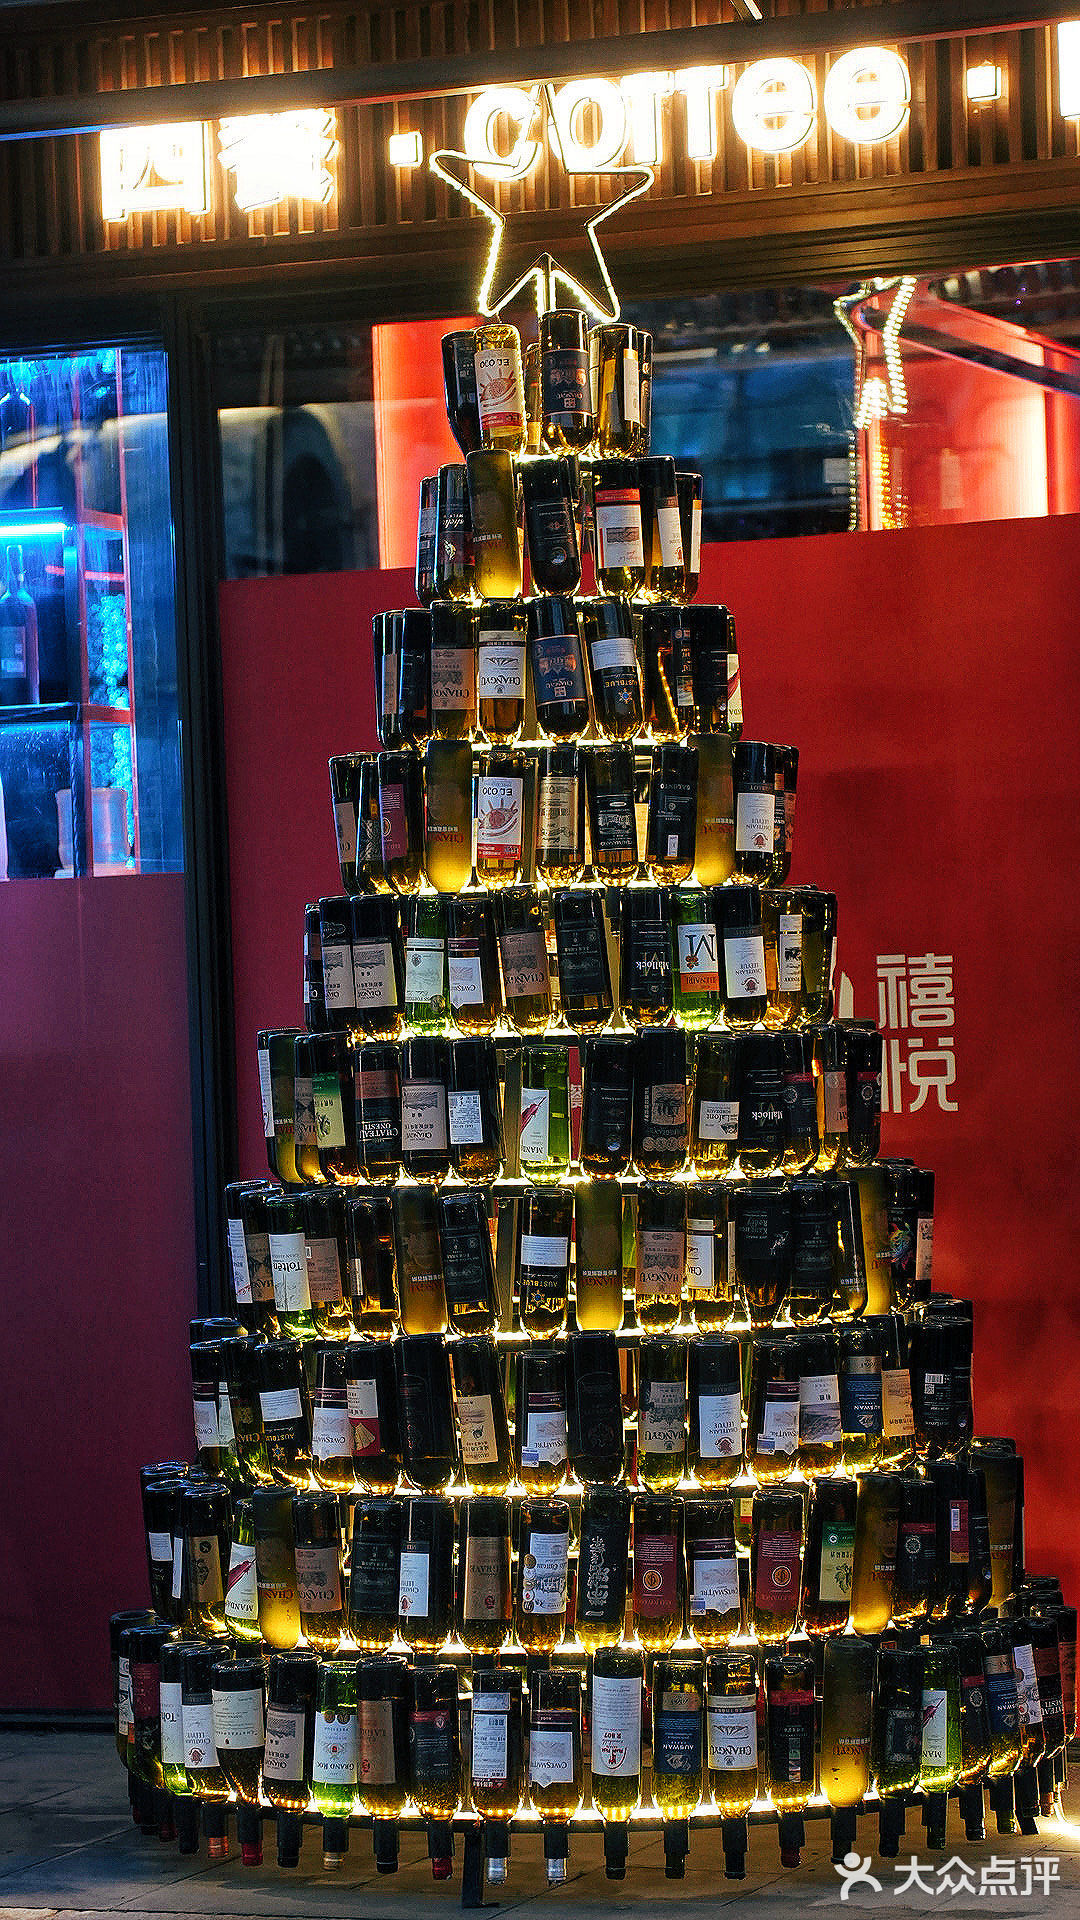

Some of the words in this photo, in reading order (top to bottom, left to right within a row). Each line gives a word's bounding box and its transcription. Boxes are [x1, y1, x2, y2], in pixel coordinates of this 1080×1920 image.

[501, 787, 513, 796] EL
[710, 1744, 752, 1756] CHANGYU
[329, 1762, 354, 1771] GRAND
